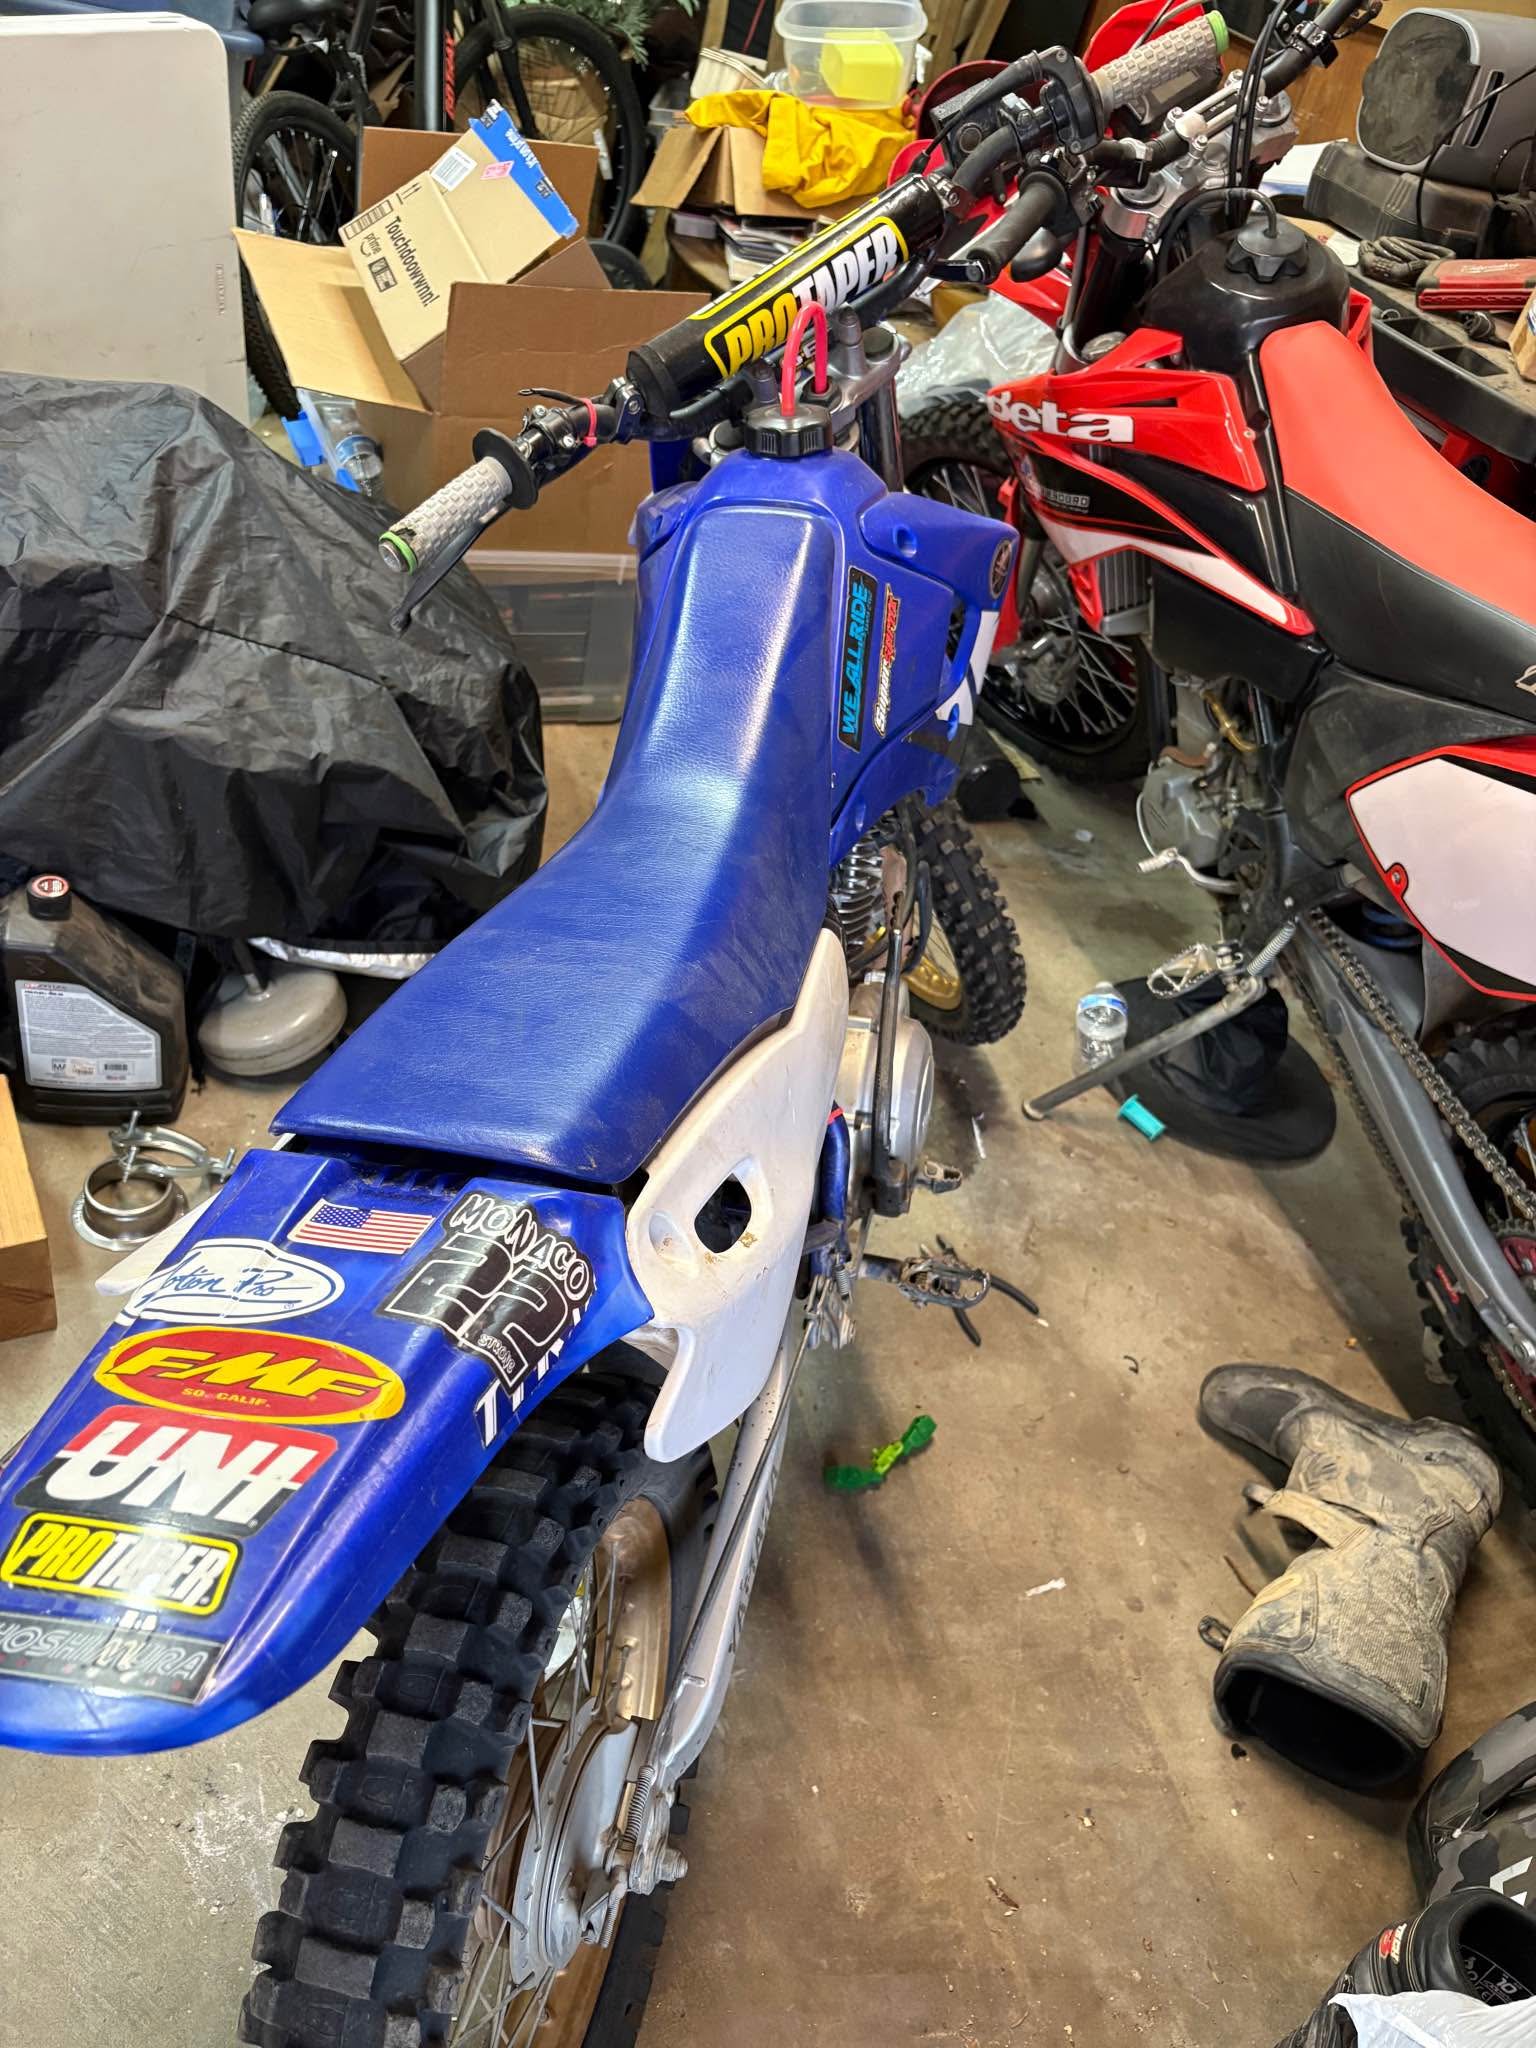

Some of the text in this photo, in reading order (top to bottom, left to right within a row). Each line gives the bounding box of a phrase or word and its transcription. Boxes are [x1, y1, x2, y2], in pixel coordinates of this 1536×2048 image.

[364, 233, 382, 255] prime
[385, 215, 439, 307] Touchdoowwnn!
[724, 224, 898, 377] PROTAPER
[987, 391, 1133, 442] Beta
[843, 583, 868, 735] WE ALL RIDE
[450, 1195, 590, 1301] MONACO
[104, 1346, 392, 1398] FMF
[477, 1334, 516, 1374] STRONG
[216, 1391, 272, 1408] CALIF.
[45, 1420, 319, 1525] UNI
